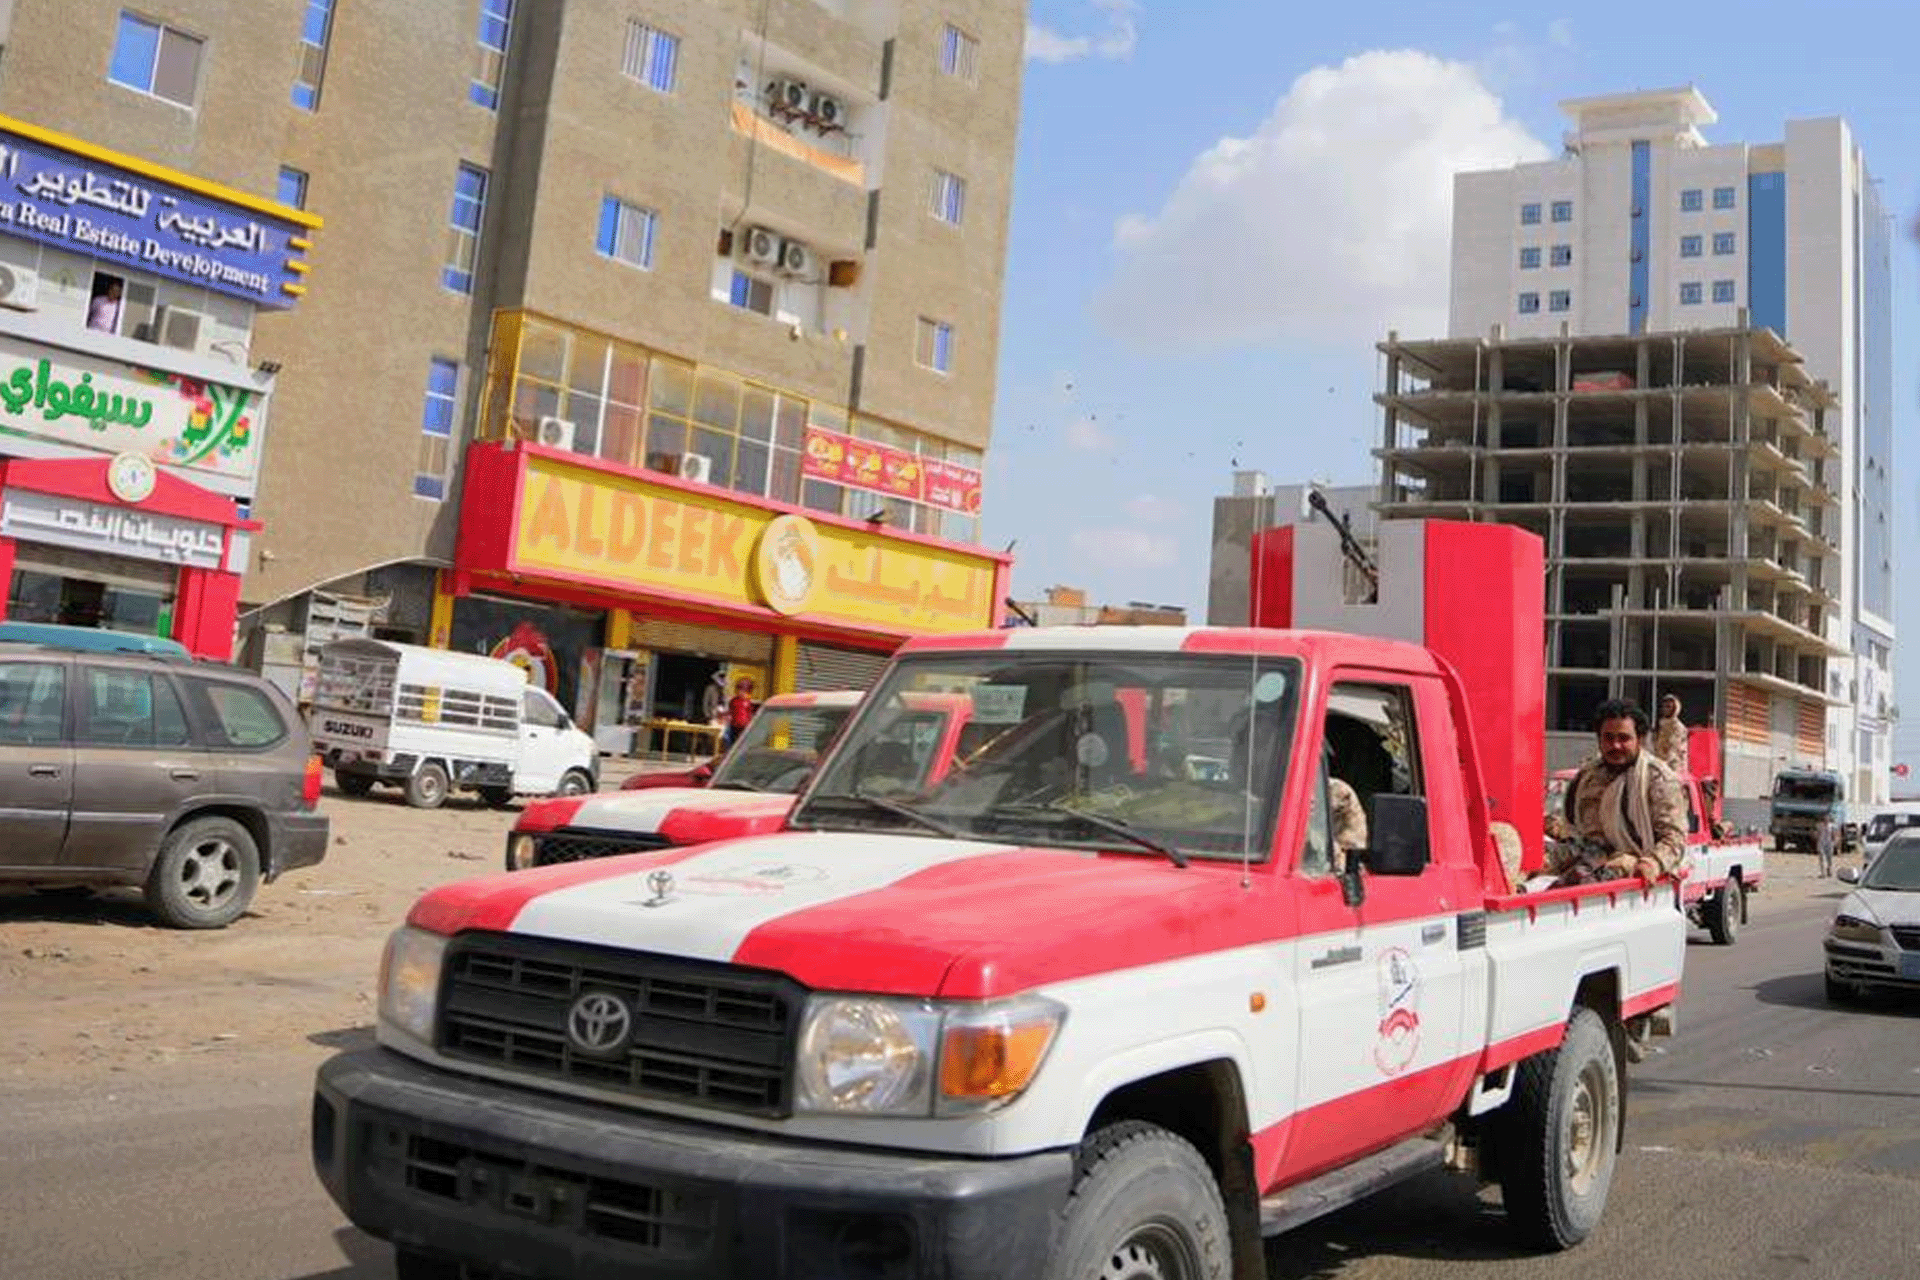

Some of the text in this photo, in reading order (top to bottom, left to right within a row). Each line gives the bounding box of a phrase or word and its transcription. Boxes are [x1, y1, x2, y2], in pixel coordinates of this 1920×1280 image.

[19, 171, 266, 254] العربية للتطوير
[20, 201, 70, 236] Real
[75, 216, 140, 255] Estate
[145, 238, 269, 292] Development
[0, 358, 153, 431] سيفواي
[527, 475, 745, 583] ALDEEK
[324, 719, 374, 740] SUZUKI
